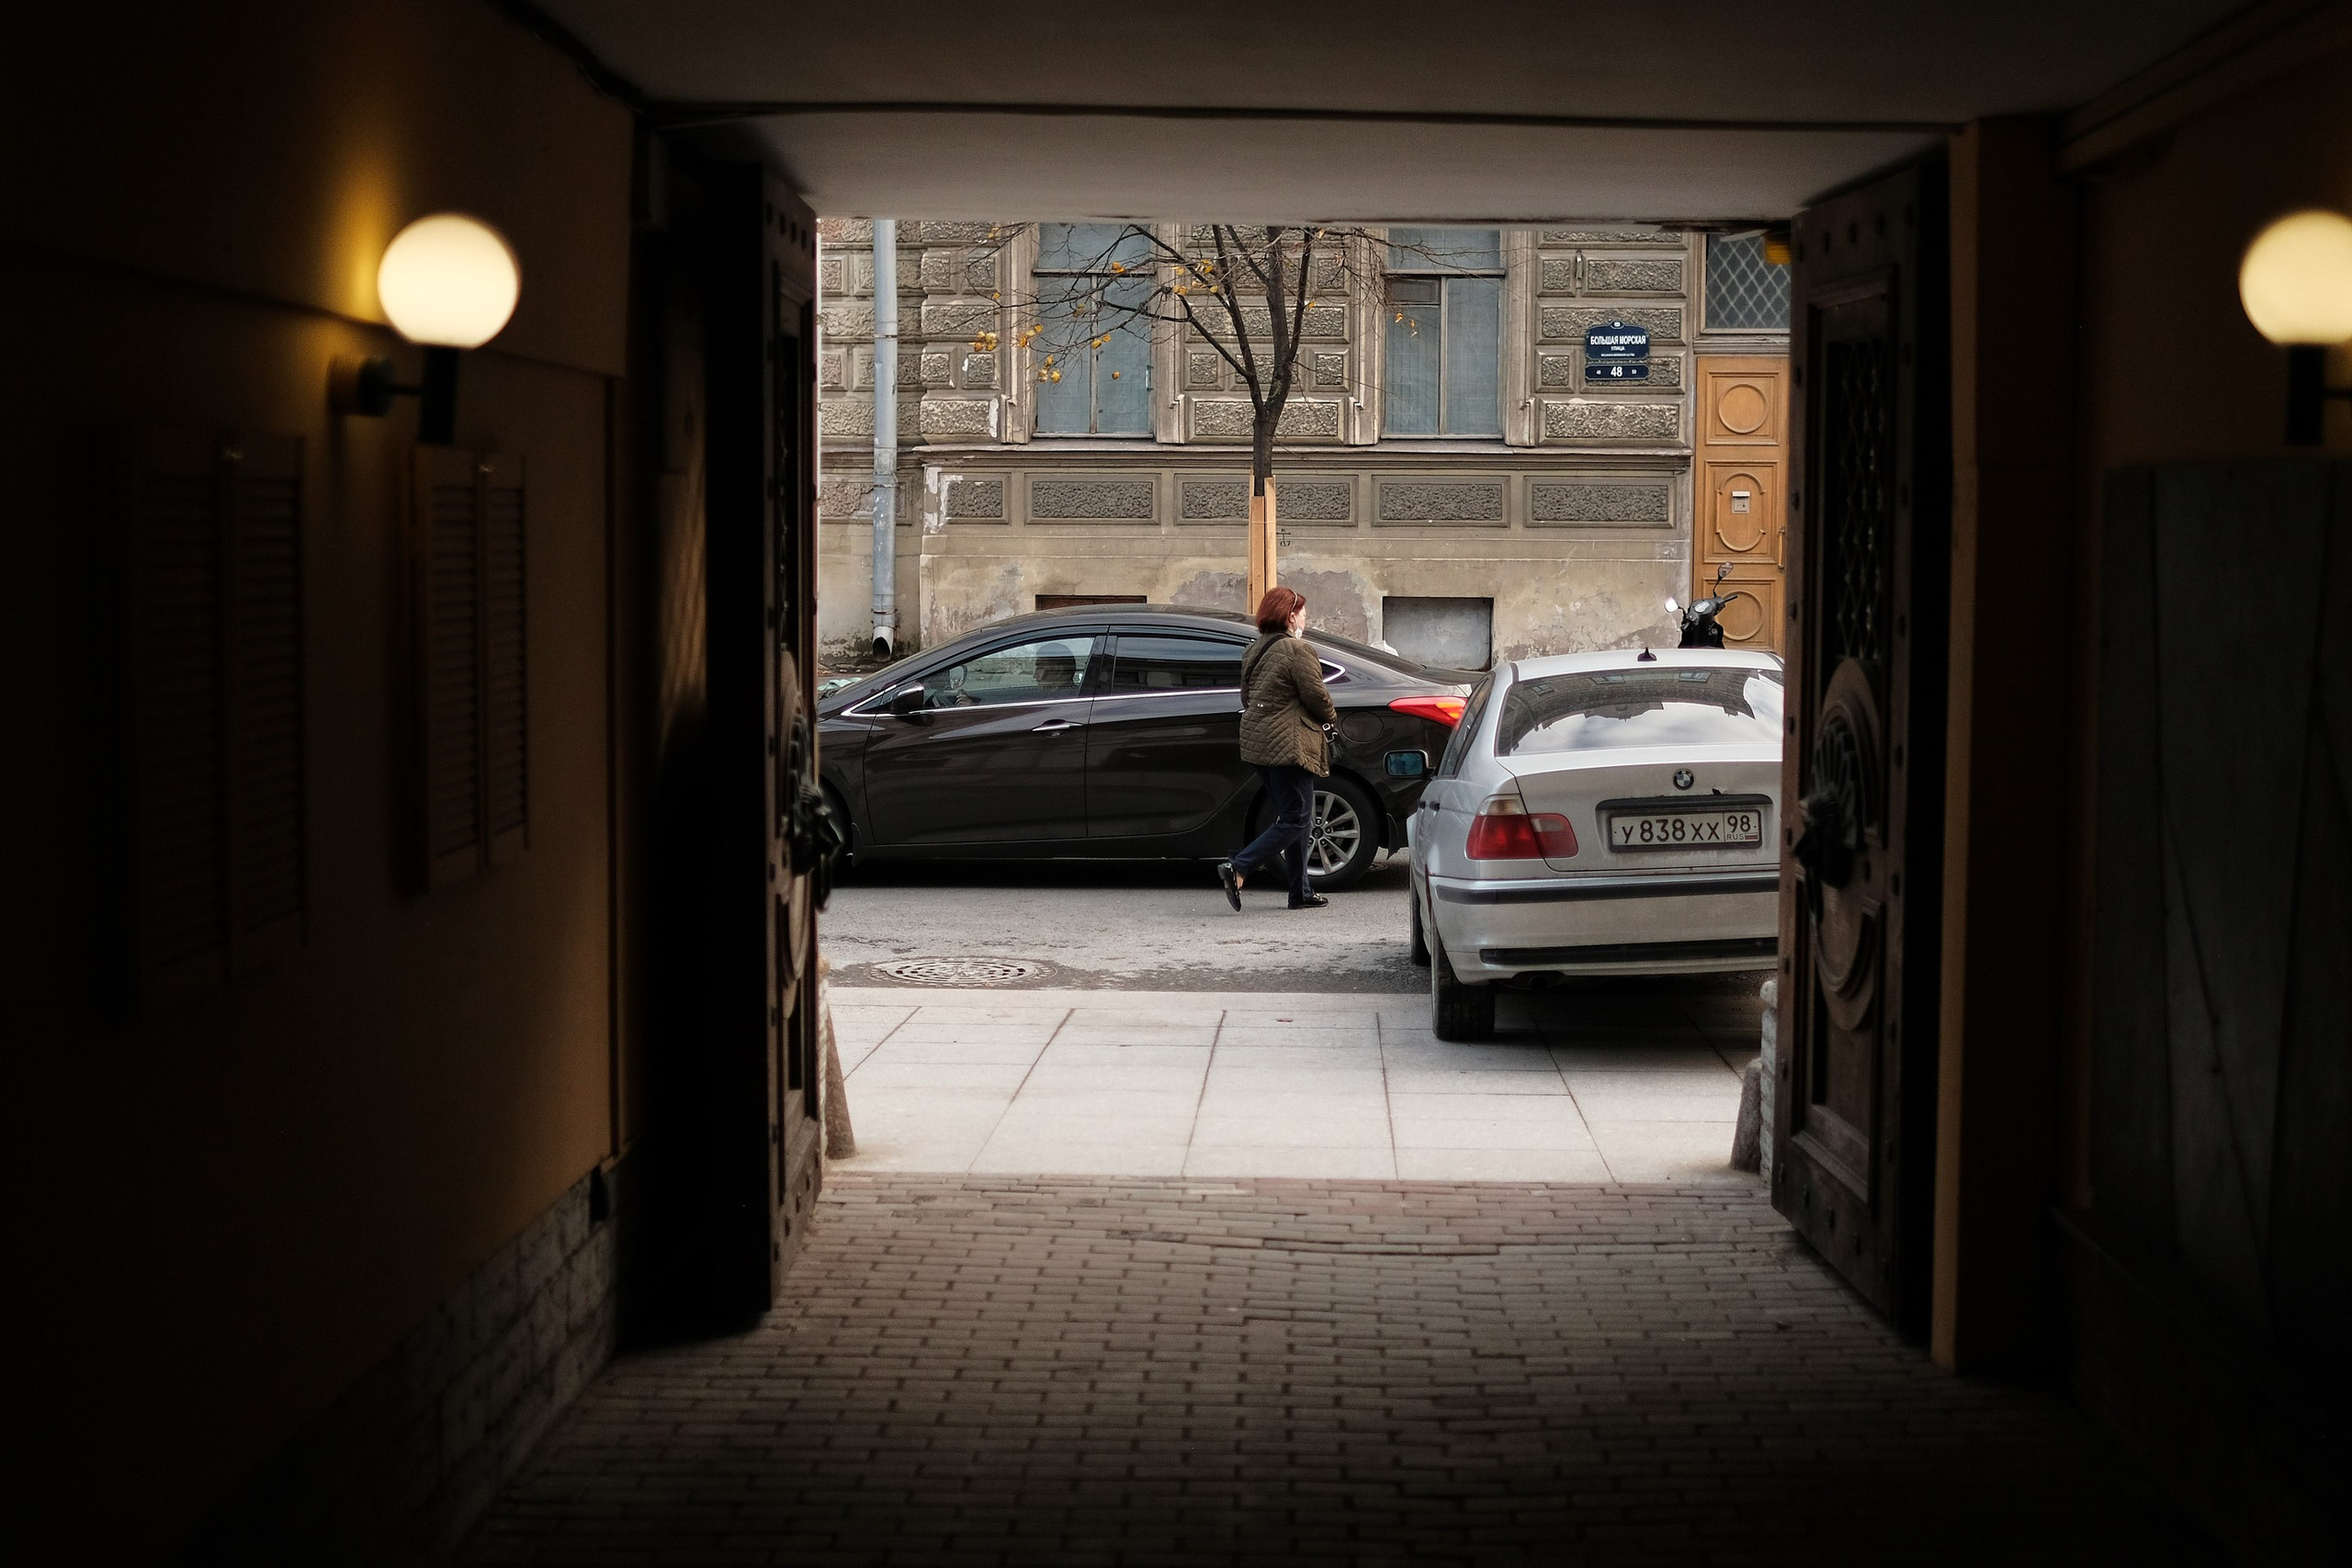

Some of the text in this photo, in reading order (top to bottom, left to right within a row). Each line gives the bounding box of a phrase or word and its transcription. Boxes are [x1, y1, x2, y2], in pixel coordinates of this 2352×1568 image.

[1590, 335, 1646, 344] БОЛЬШАЯ МОРСКАЯ
[1611, 367, 1623, 377] 48
[1727, 815, 1751, 833] 98
